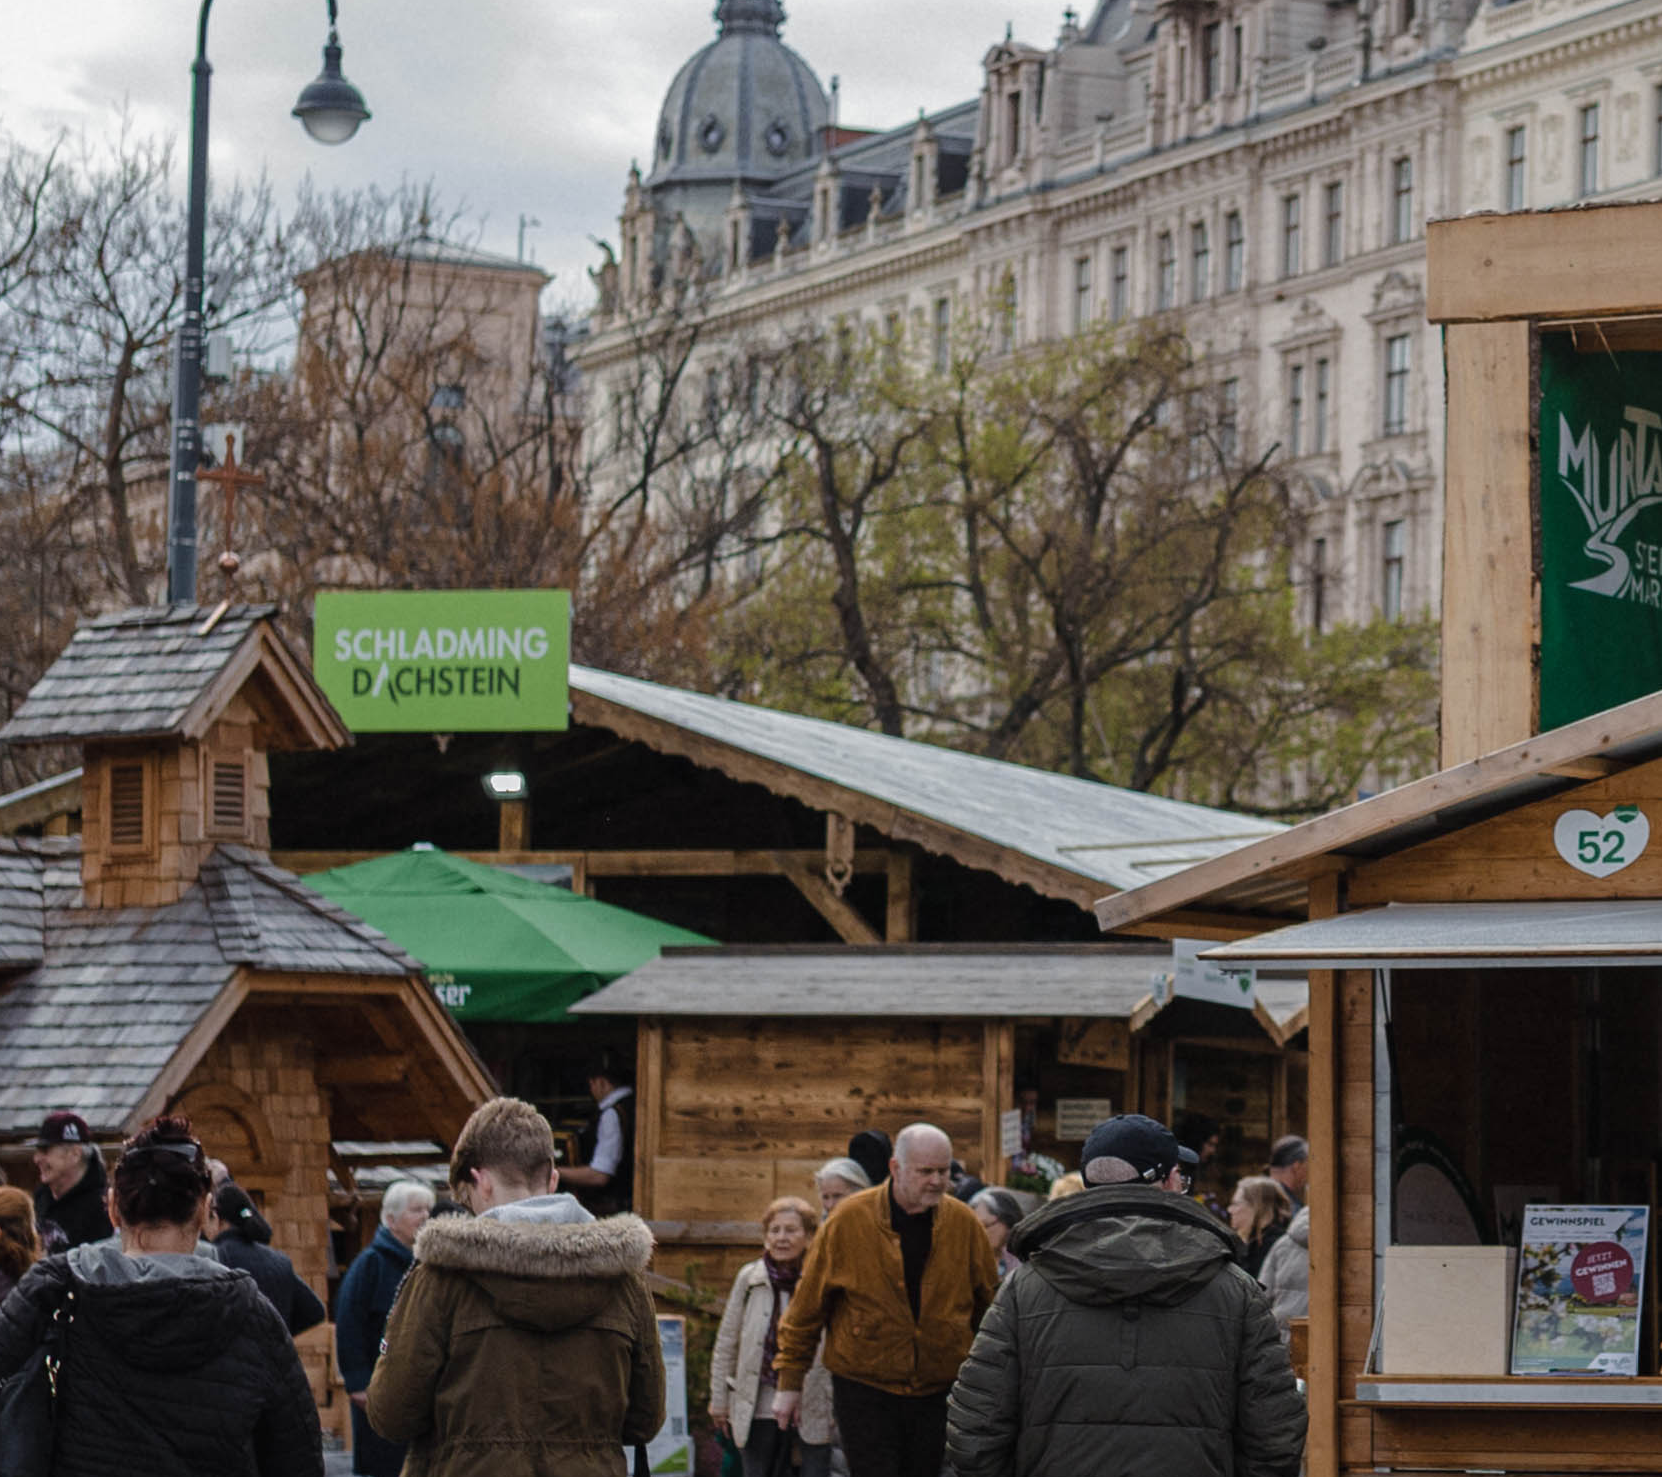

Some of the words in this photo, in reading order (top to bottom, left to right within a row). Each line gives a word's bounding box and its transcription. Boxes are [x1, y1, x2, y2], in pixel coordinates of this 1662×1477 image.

[334, 627, 549, 662] SCHLADMING
[352, 662, 521, 705] DACHSTEIN
[1578, 830, 1625, 864] 52
[434, 984, 472, 1007] ser
[1529, 1217, 1606, 1227] GEWINNSPIEL
[1575, 1259, 1628, 1277] GEWINNEN
